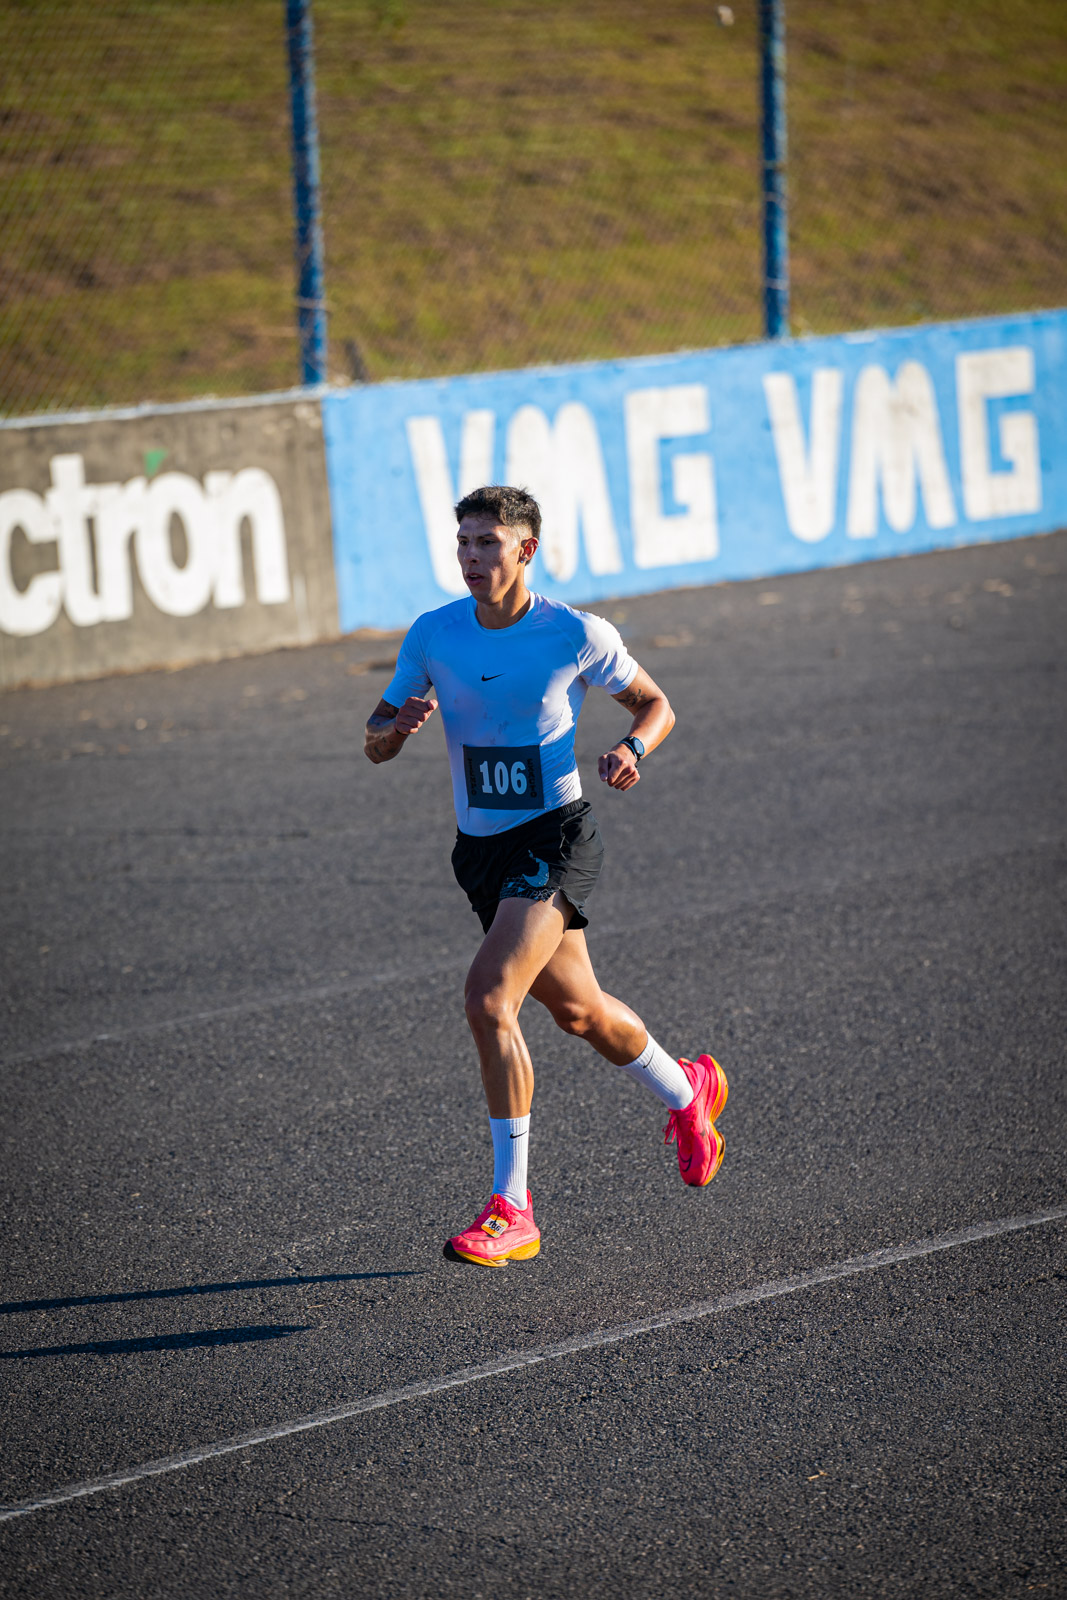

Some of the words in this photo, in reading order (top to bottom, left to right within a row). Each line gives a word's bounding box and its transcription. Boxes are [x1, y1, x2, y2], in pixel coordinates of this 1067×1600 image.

[407, 384, 720, 595] VMG
[763, 346, 1042, 542] VMG
[479, 760, 528, 795] 106
[527, 758, 538, 798] EXACTO
